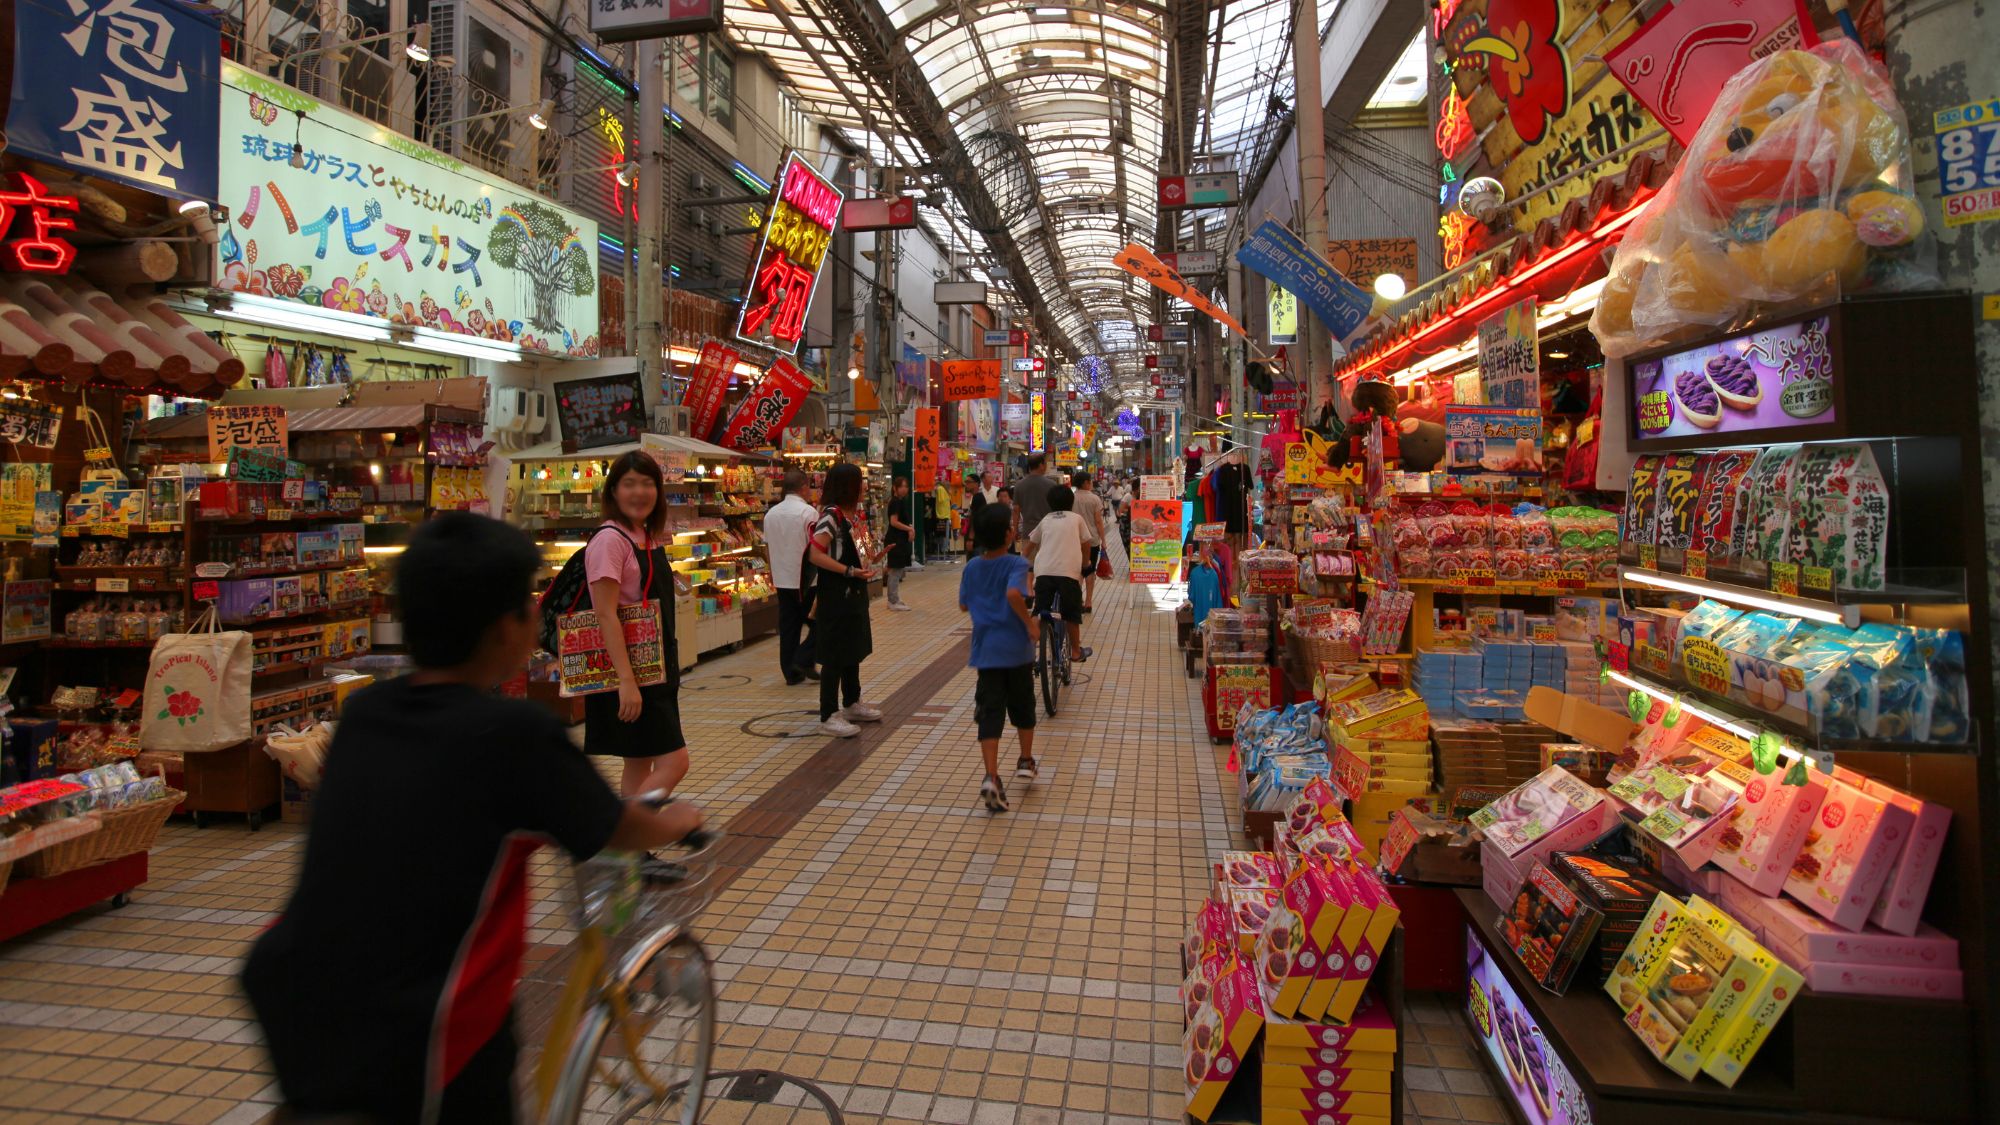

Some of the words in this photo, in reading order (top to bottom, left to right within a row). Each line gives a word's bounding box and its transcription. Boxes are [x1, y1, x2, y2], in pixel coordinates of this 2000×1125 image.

[60, 0, 188, 190] 泡盛
[242, 134, 485, 224] 琉球ガラスとやちむんの店
[785, 161, 841, 232] OKINAWA
[0, 171, 80, 275] 店
[238, 181, 482, 288] ハイビスカス
[767, 201, 832, 273] おみやげ
[1354, 254, 1415, 270] ケン坊の店
[1481, 340, 1536, 381] 全国無料発送
[1741, 322, 1826, 363] べにいも
[1777, 349, 1834, 385] たると
[1449, 421, 1538, 441] 雪塩ちんすこう
[1639, 416, 1670, 430] 100%使用
[1640, 404, 1668, 417] べにいも
[217, 418, 281, 445] 泡盛
[1632, 470, 1653, 529] アグー
[1665, 469, 1698, 533] アグー
[1450, 569, 1496, 578] 袋入ちんすこう
[1217, 687, 1269, 711] 特大
[1700, 672, 1728, 696] ¥300
